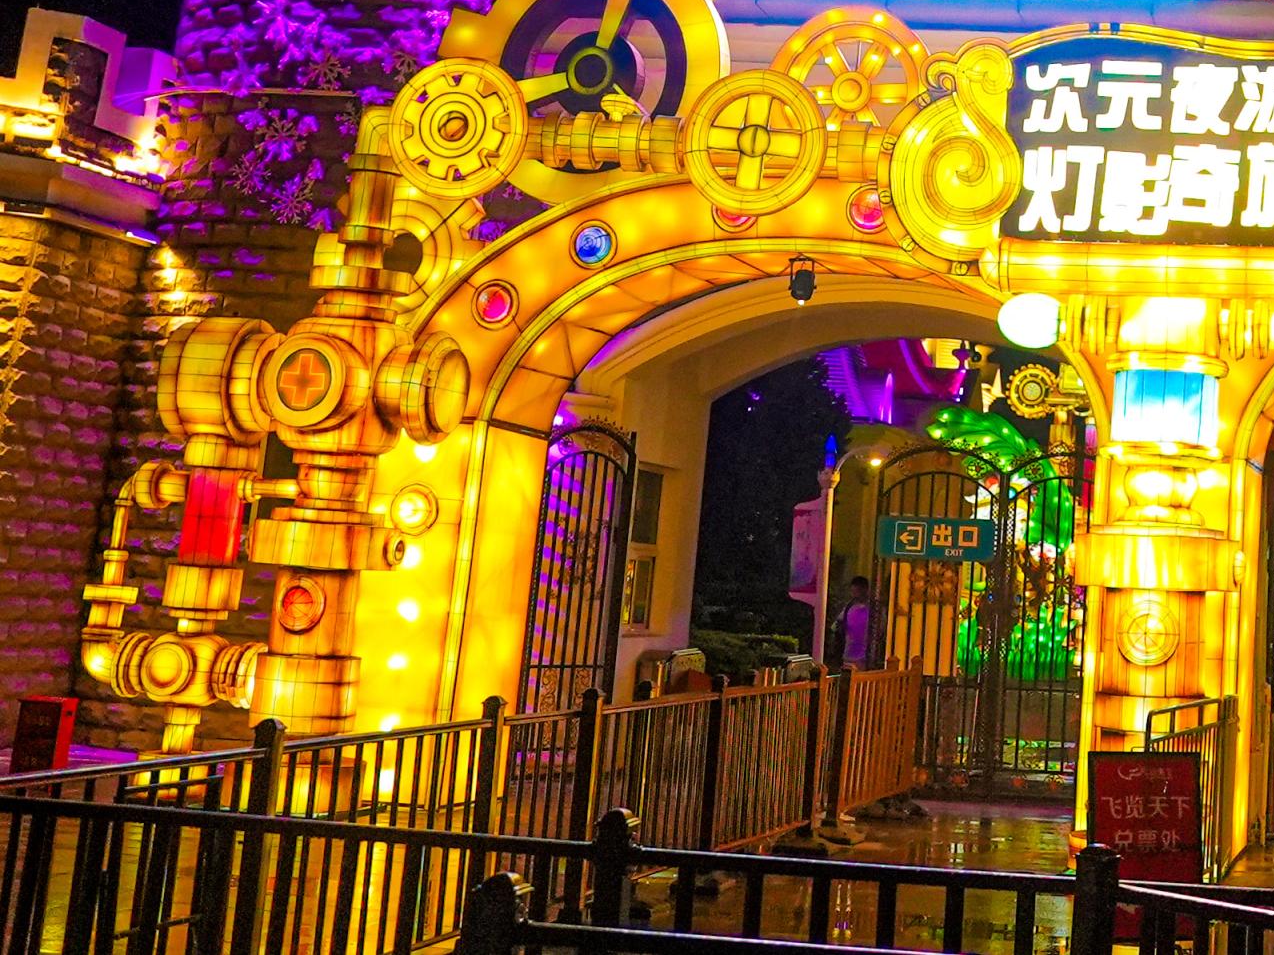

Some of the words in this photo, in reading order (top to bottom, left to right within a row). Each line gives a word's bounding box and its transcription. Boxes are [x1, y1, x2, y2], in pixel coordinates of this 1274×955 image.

[931, 524, 979, 548] 出口
[944, 549, 965, 557] EXIT
[1101, 795, 1191, 820] 飞览天下
[1113, 829, 1182, 853] 兑票处
